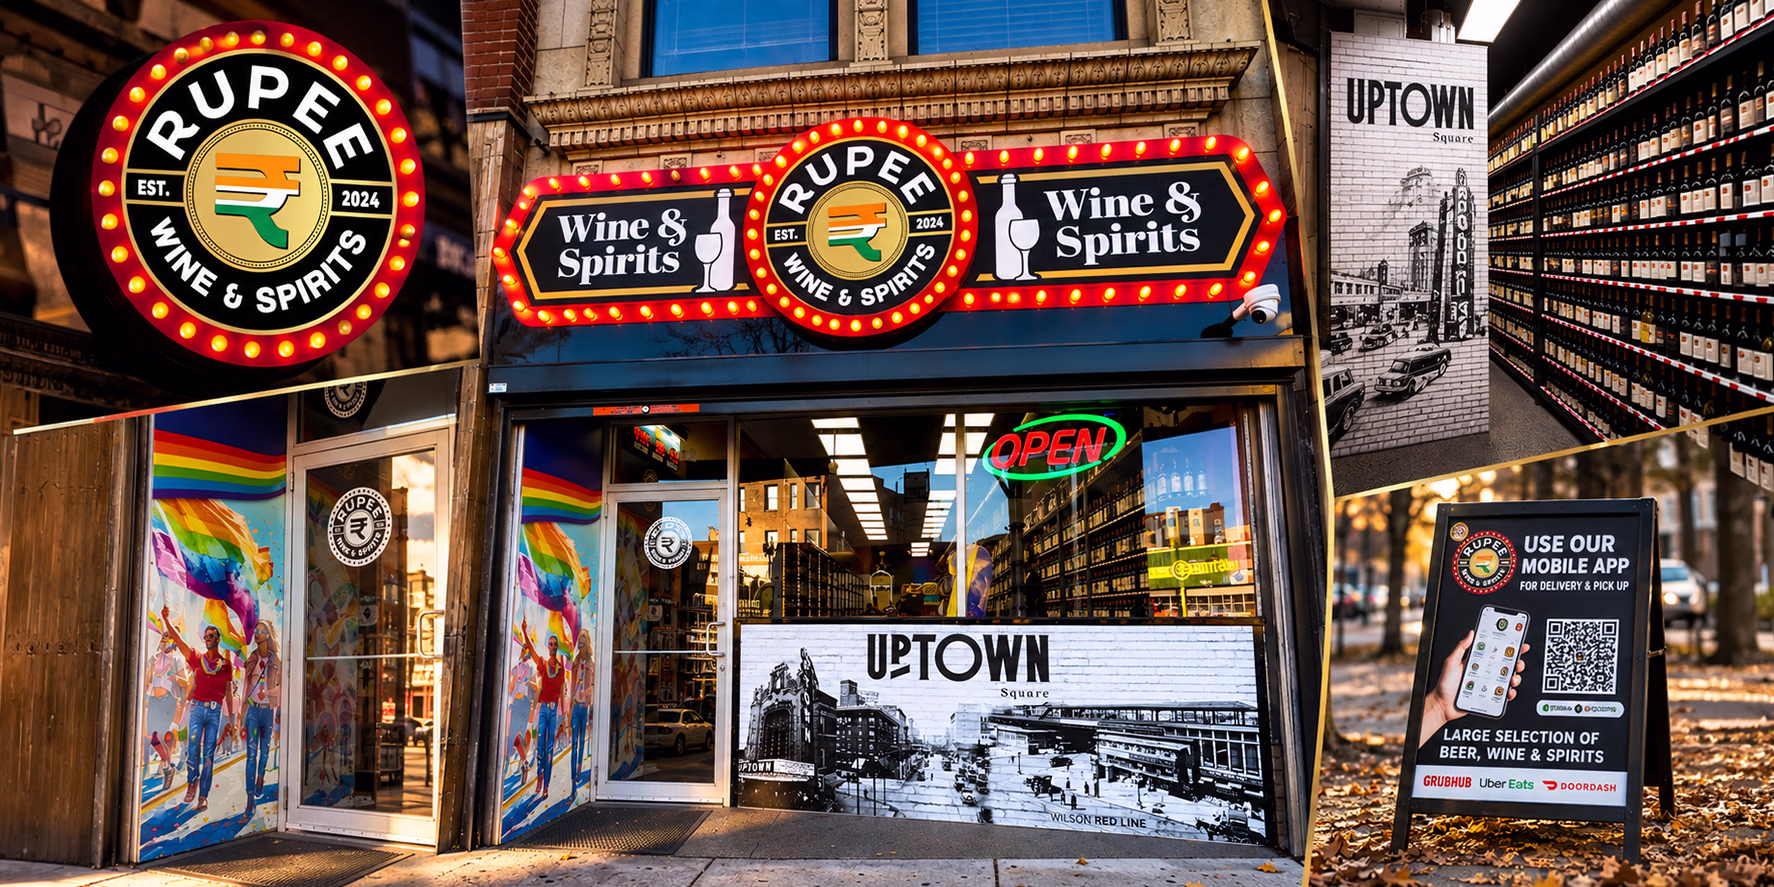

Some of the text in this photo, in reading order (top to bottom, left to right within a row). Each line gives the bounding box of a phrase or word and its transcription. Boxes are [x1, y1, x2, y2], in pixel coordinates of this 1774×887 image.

[1347, 78, 1473, 129] UPTOWN
[147, 66, 373, 169] RUPEE
[1433, 131, 1473, 145] Square
[138, 180, 169, 196] EST.
[779, 146, 936, 214] RUPEE
[342, 191, 379, 208] 2024
[1044, 182, 1201, 222] Wine &
[558, 209, 686, 246] Wine &
[917, 217, 943, 229] 2024
[775, 229, 798, 240] EST.
[1057, 221, 1200, 265] Spirits
[152, 217, 217, 296] WINE
[224, 283, 242, 308] &
[257, 230, 365, 313] SPIRITS
[558, 244, 679, 285] Spirits
[784, 244, 934, 306] WINE & SPIRITS
[992, 427, 1106, 469] OPEN
[338, 497, 382, 522] RUPEE
[1464, 538, 1507, 556] RUPEE
[1525, 535, 1615, 552] USE OUR
[1522, 558, 1629, 573] MOBILE APP
[1520, 581, 1629, 590] FOR DELIVERY & PICK UP
[868, 634, 1049, 682] UPTOWN
[1001, 688, 1049, 700] Square
[1444, 729, 1599, 744] LARGE SELECTION OF
[1440, 746, 1603, 763] BEER, WINE & SPIRITS
[1424, 774, 1471, 788] GRUBHUB
[1480, 779, 1534, 790] Uber Eats
[1561, 783, 1616, 791] DOORDASH
[1052, 814, 1146, 828] WILSON RED LINE
